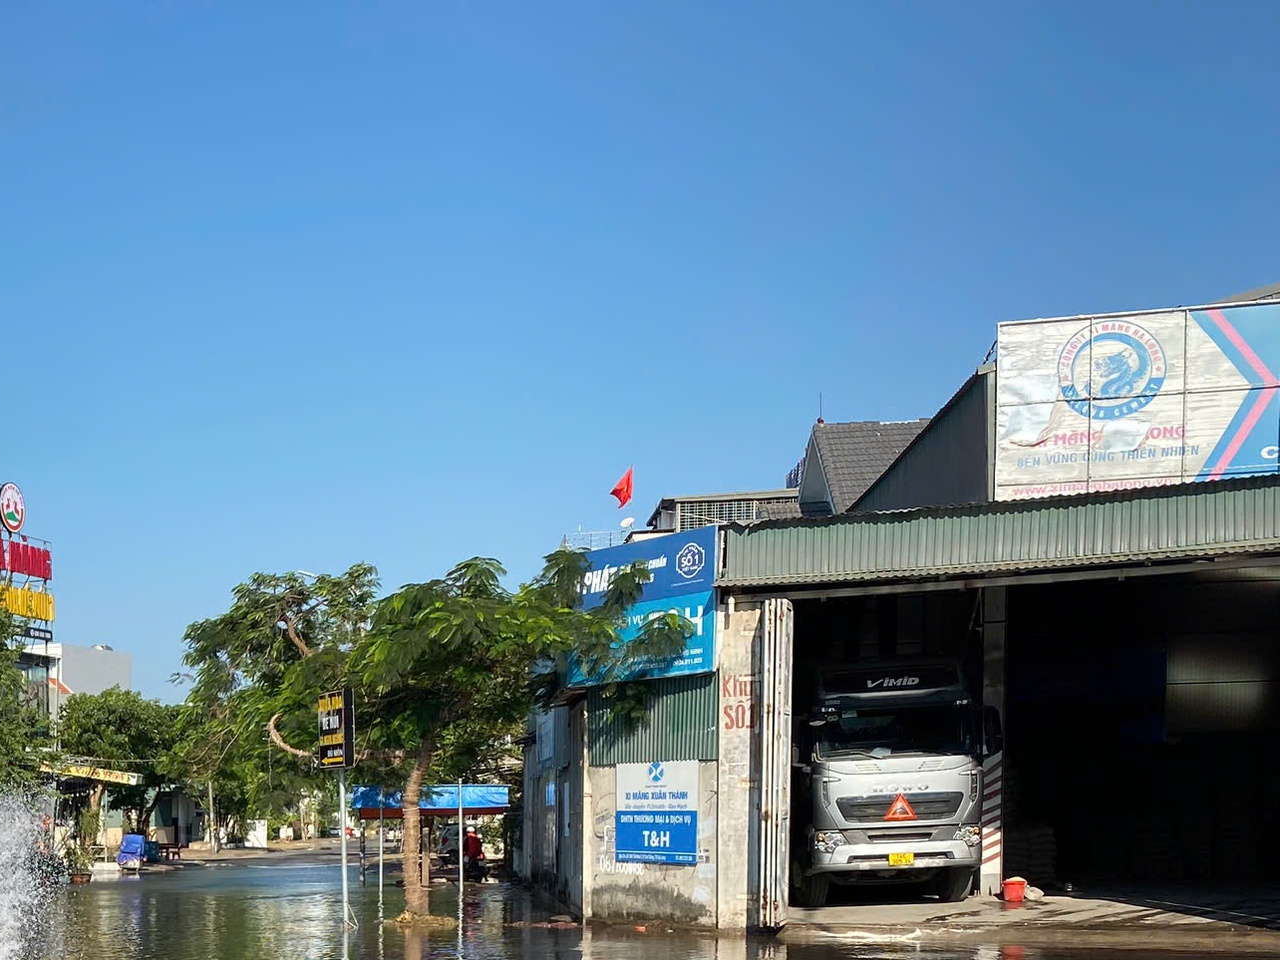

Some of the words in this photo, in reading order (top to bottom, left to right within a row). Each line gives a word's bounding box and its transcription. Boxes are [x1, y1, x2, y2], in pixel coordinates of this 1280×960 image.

[1114, 383, 1158, 417] CEMET
[1145, 424, 1186, 441] ONG
[8, 535, 53, 580] HÀNG
[642, 830, 670, 848] T&H
